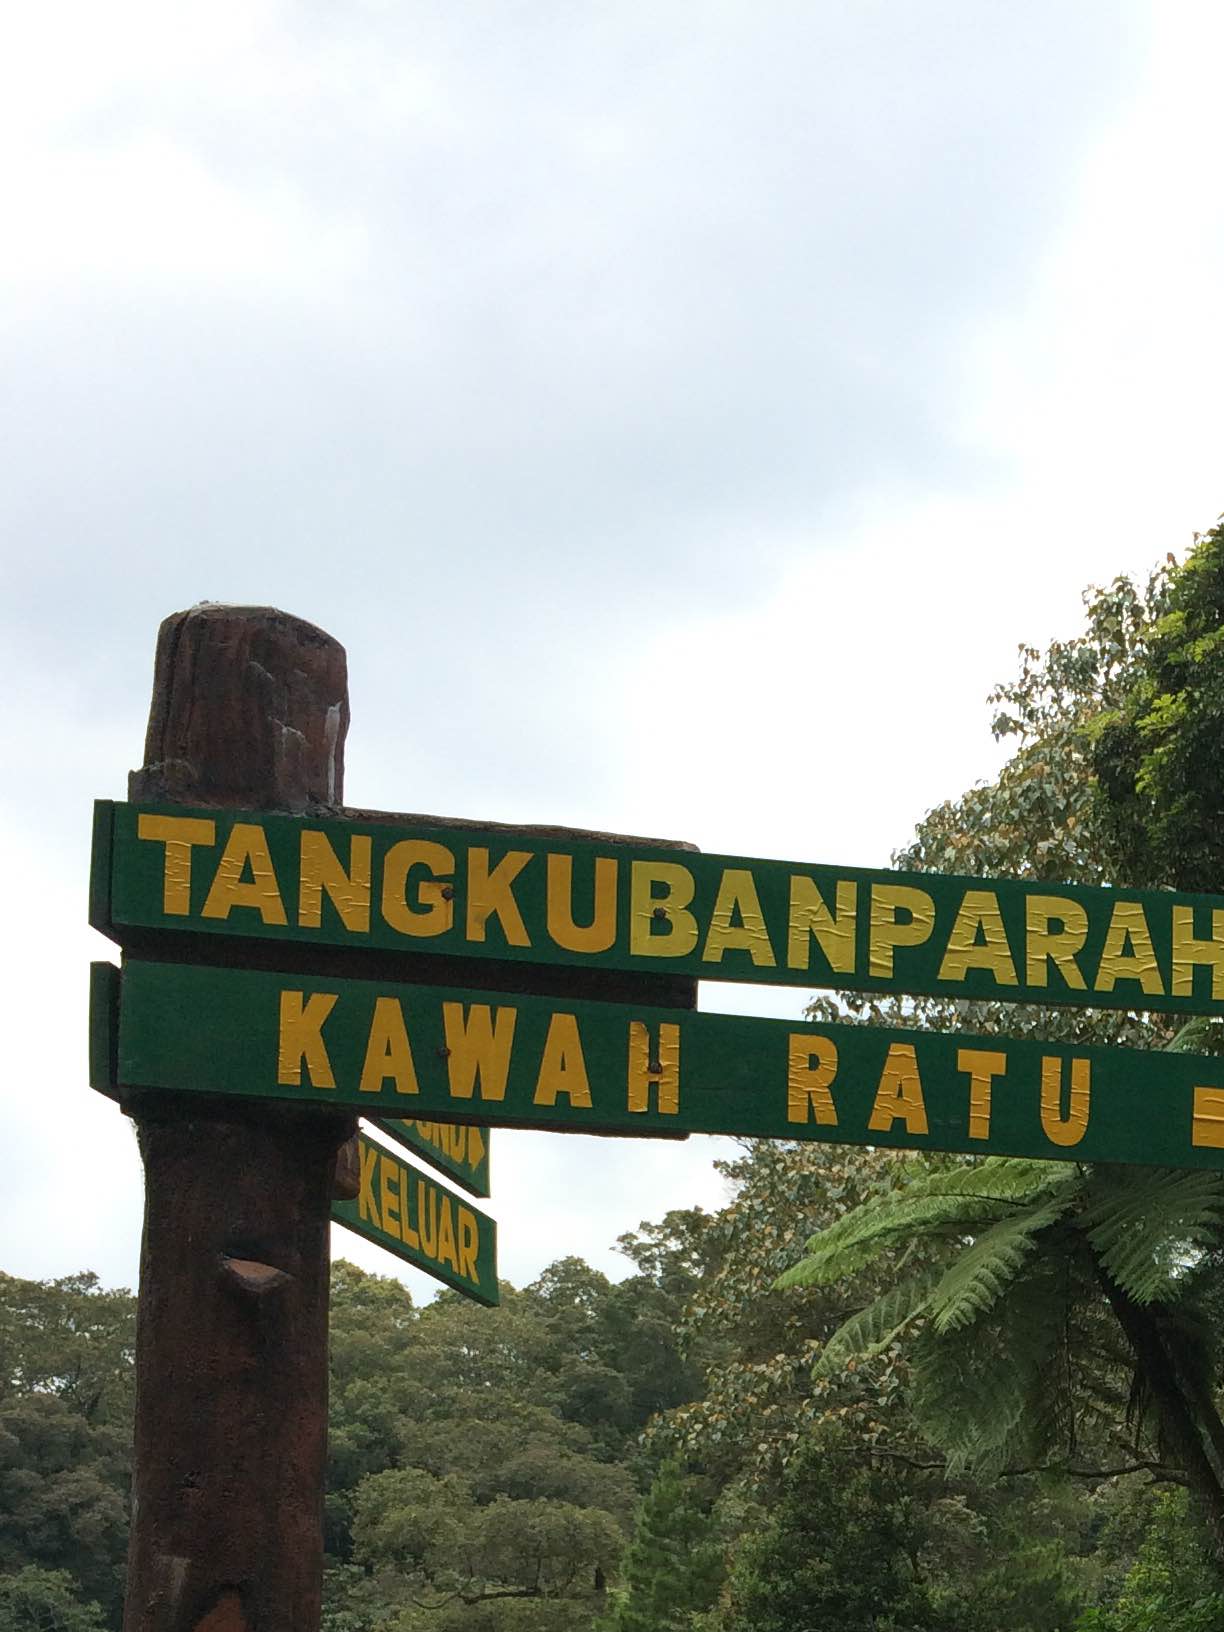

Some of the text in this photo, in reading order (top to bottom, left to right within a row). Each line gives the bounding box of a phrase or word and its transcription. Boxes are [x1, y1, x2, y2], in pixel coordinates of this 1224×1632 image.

[277, 990, 1092, 1147] KAWAH RATU
[358, 1138, 481, 1286] KELUAR
